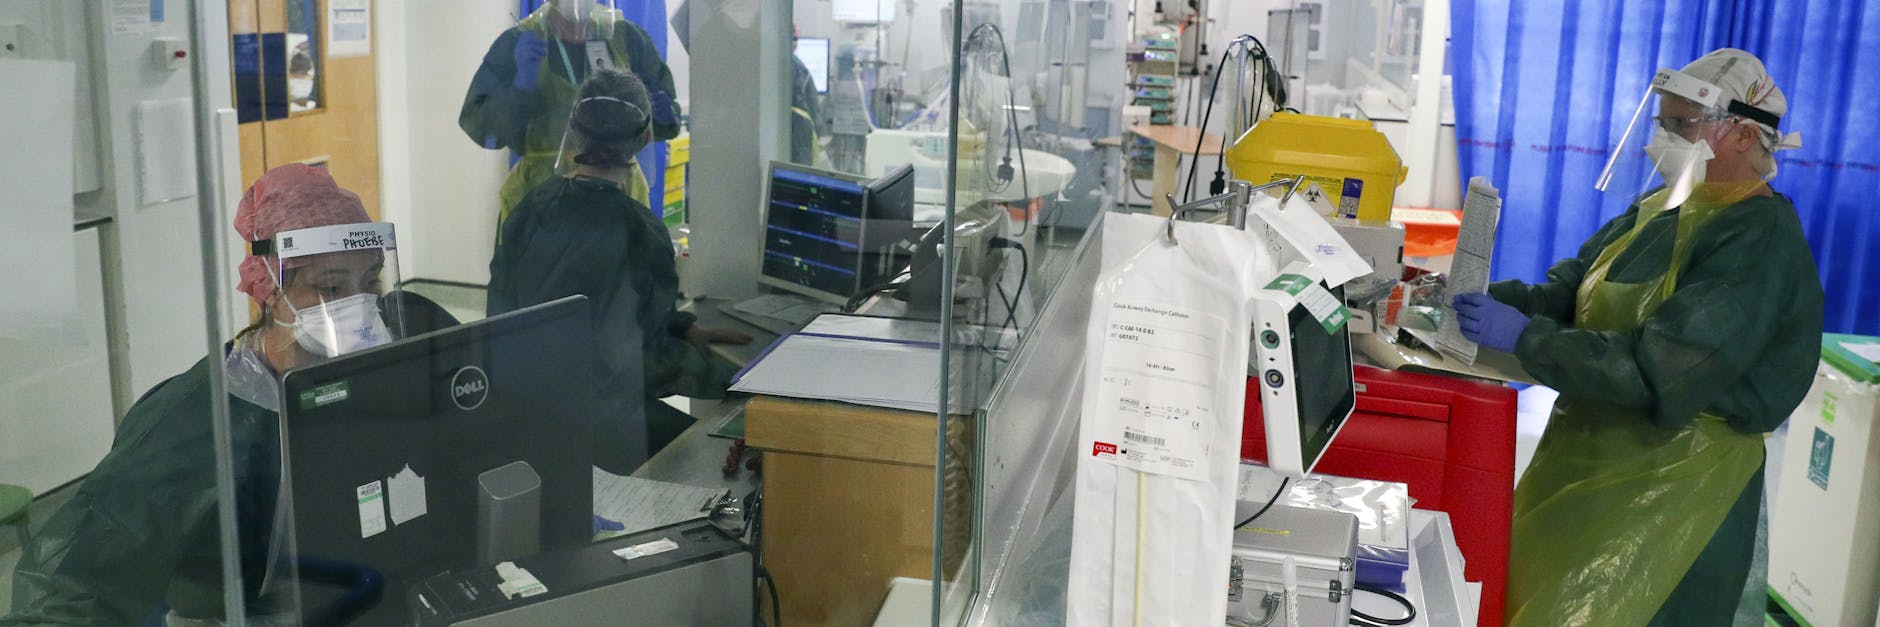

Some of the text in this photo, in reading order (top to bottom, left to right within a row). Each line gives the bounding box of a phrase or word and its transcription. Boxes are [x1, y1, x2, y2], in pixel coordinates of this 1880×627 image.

[349, 230, 376, 238] PHYSIO
[343, 235, 384, 249] PHOEBE
[1127, 304, 1144, 312] Airway
[1144, 306, 1168, 316] Exchange
[1168, 310, 1190, 319] Catheter
[455, 380, 485, 398] DELL
[1095, 444, 1115, 453] COOK
